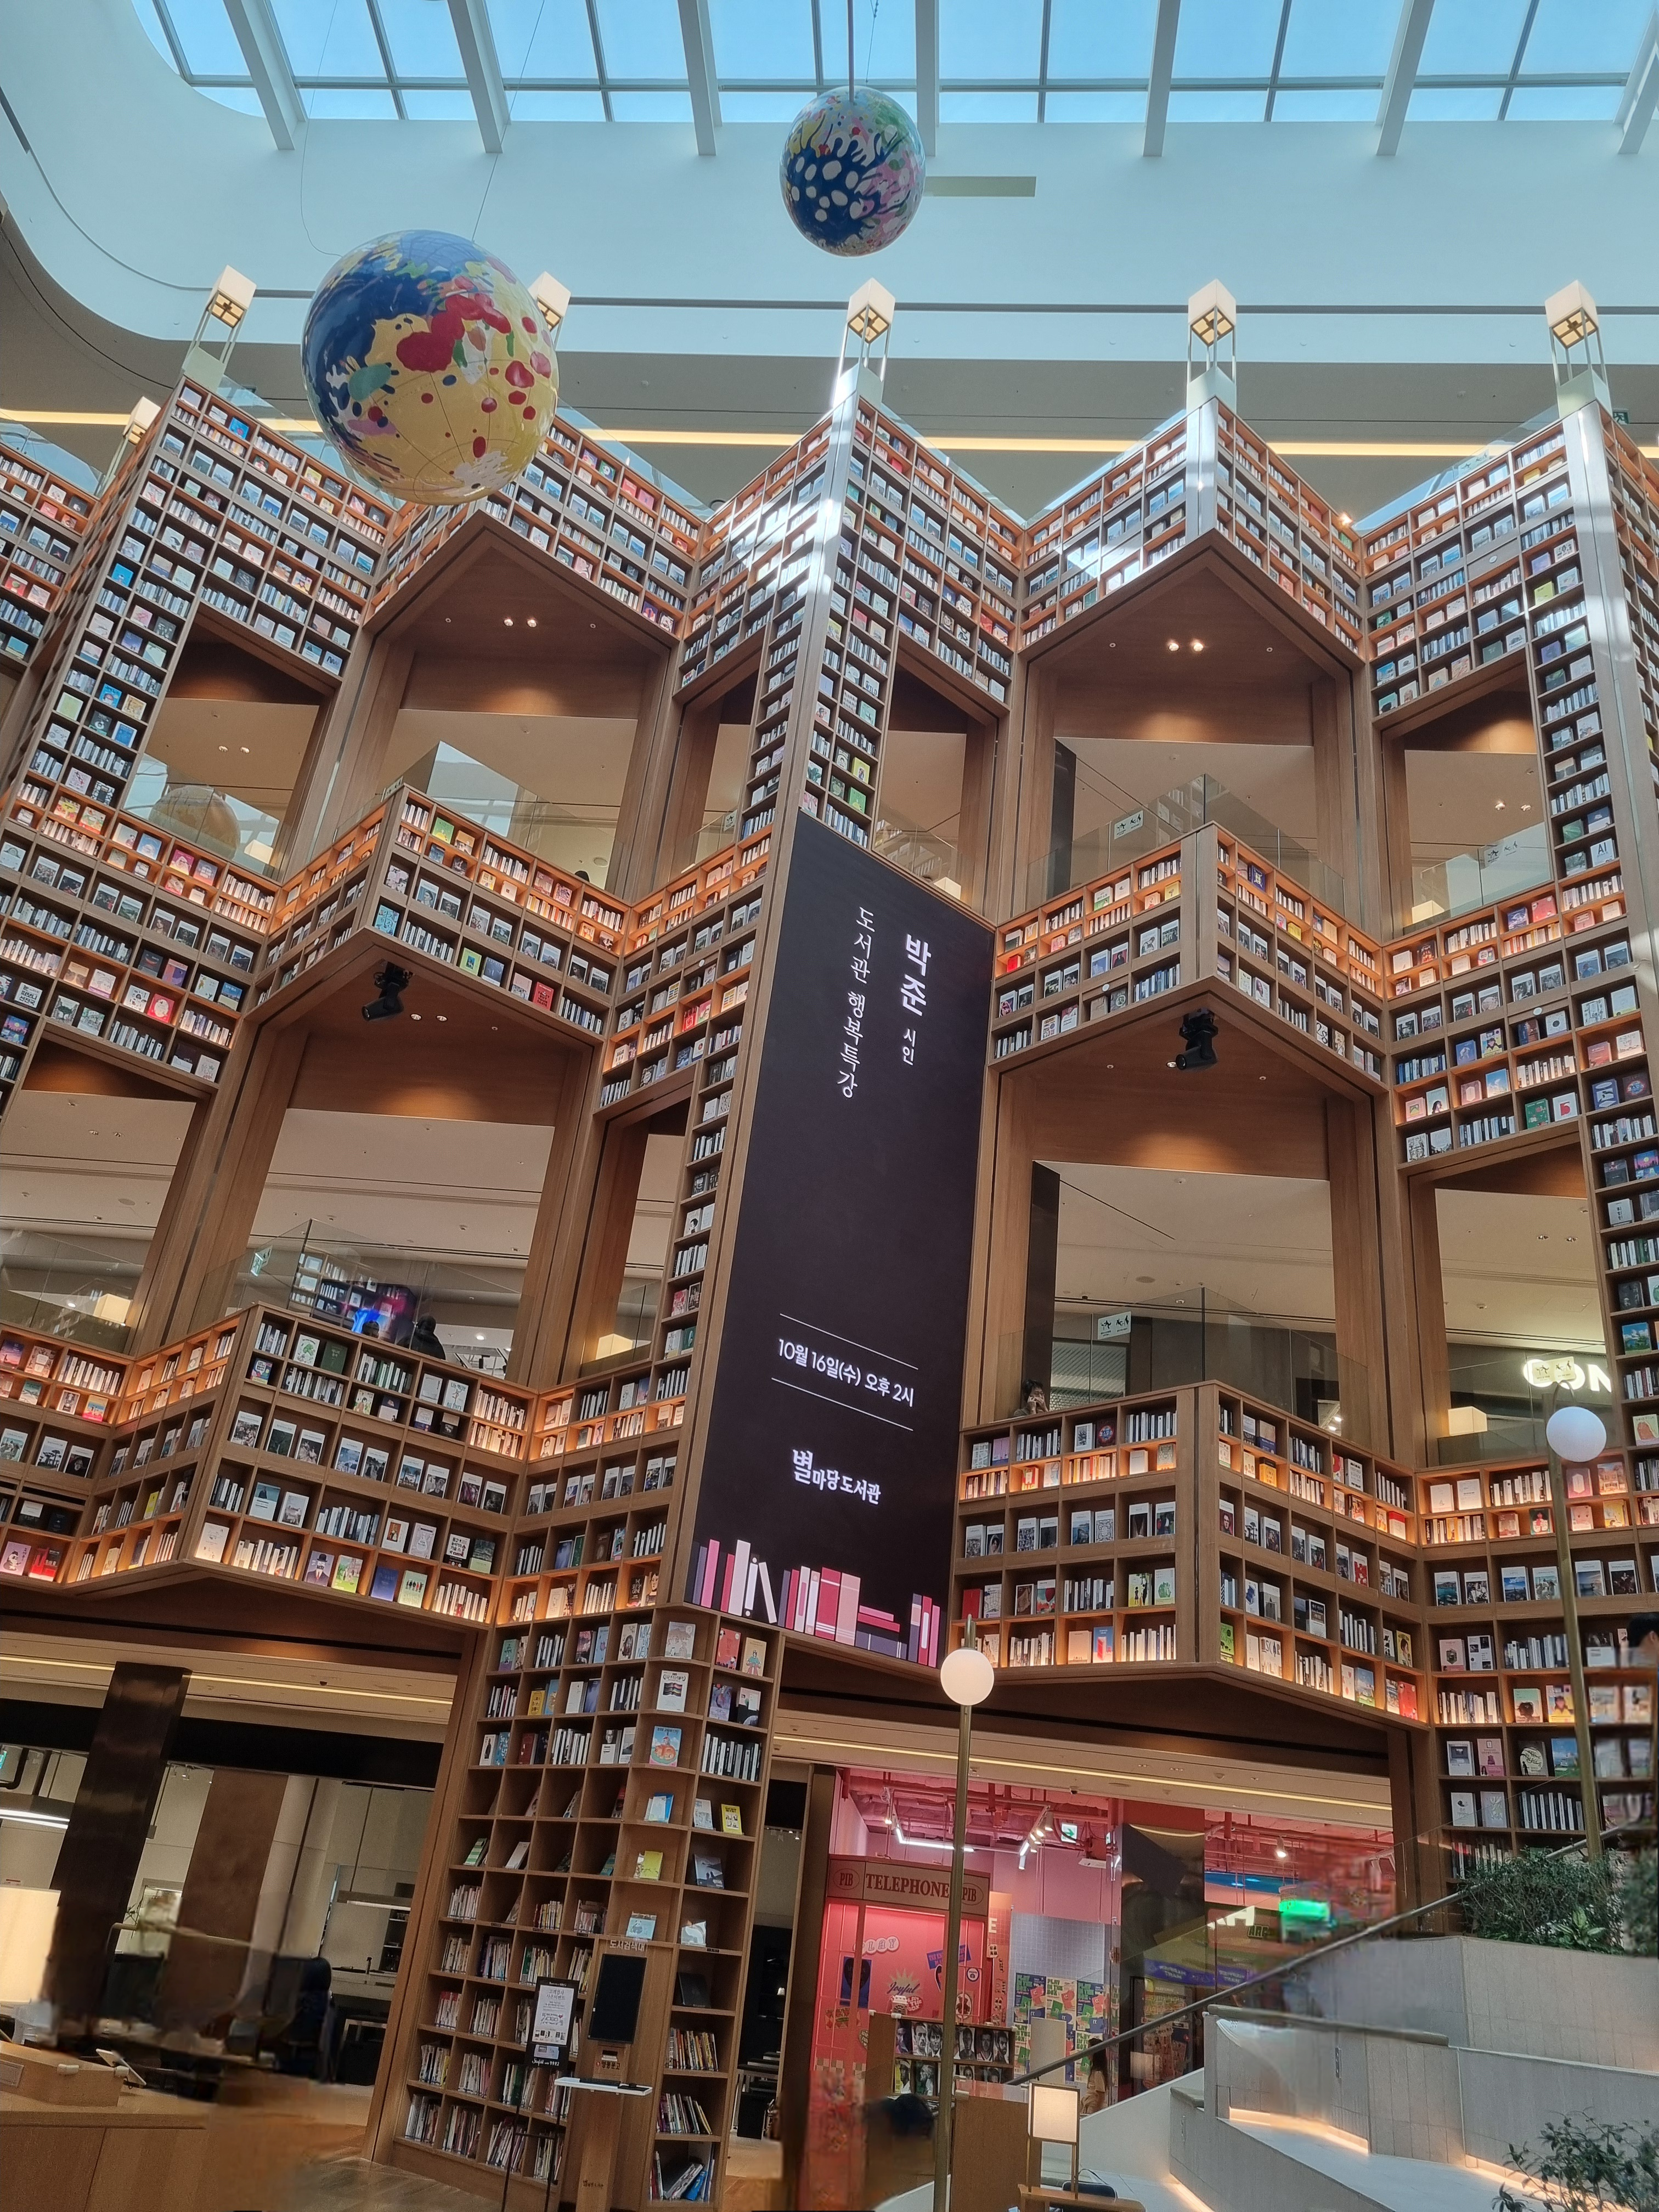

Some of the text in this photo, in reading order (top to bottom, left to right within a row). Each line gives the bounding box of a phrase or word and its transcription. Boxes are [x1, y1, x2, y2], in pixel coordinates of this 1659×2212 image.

[1598, 842, 1607, 854] AI
[837, 907, 875, 1098] 도서관 행복특강
[901, 934, 932, 1066] 박준 시인
[779, 1339, 914, 1407] 10월 16일(수) 오후 2시
[840, 1872, 854, 1886] PIB
[866, 1873, 950, 1898] TELEPHONE
[962, 1887, 977, 1902] PIB
[863, 1938, 896, 1953] LAY
[887, 1981, 921, 1995] Joyful
